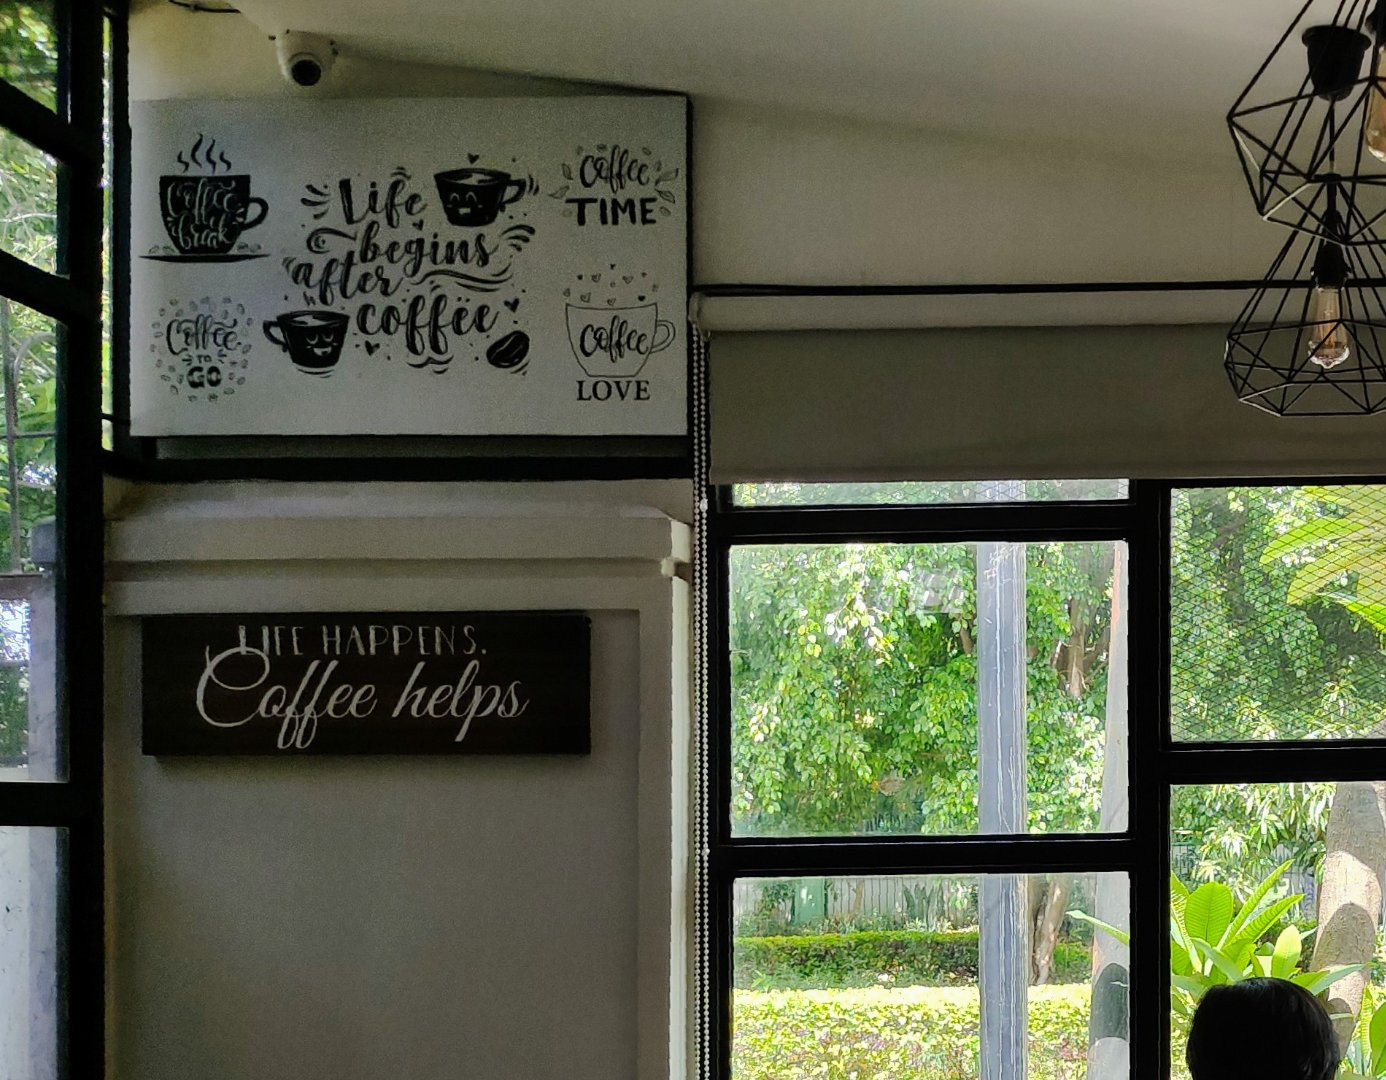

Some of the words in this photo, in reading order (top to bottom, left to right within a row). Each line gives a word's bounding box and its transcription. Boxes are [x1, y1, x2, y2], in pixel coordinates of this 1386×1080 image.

[338, 178, 428, 228] Life
[565, 197, 658, 226] TIME
[360, 220, 500, 277] begins
[291, 250, 403, 306] after
[187, 365, 221, 389] GO
[576, 380, 651, 401] LOVE
[238, 624, 304, 656] LIFE
[322, 624, 488, 656] HAPPENS.
[196, 645, 378, 749] Coffee
[391, 659, 530, 743] helps
